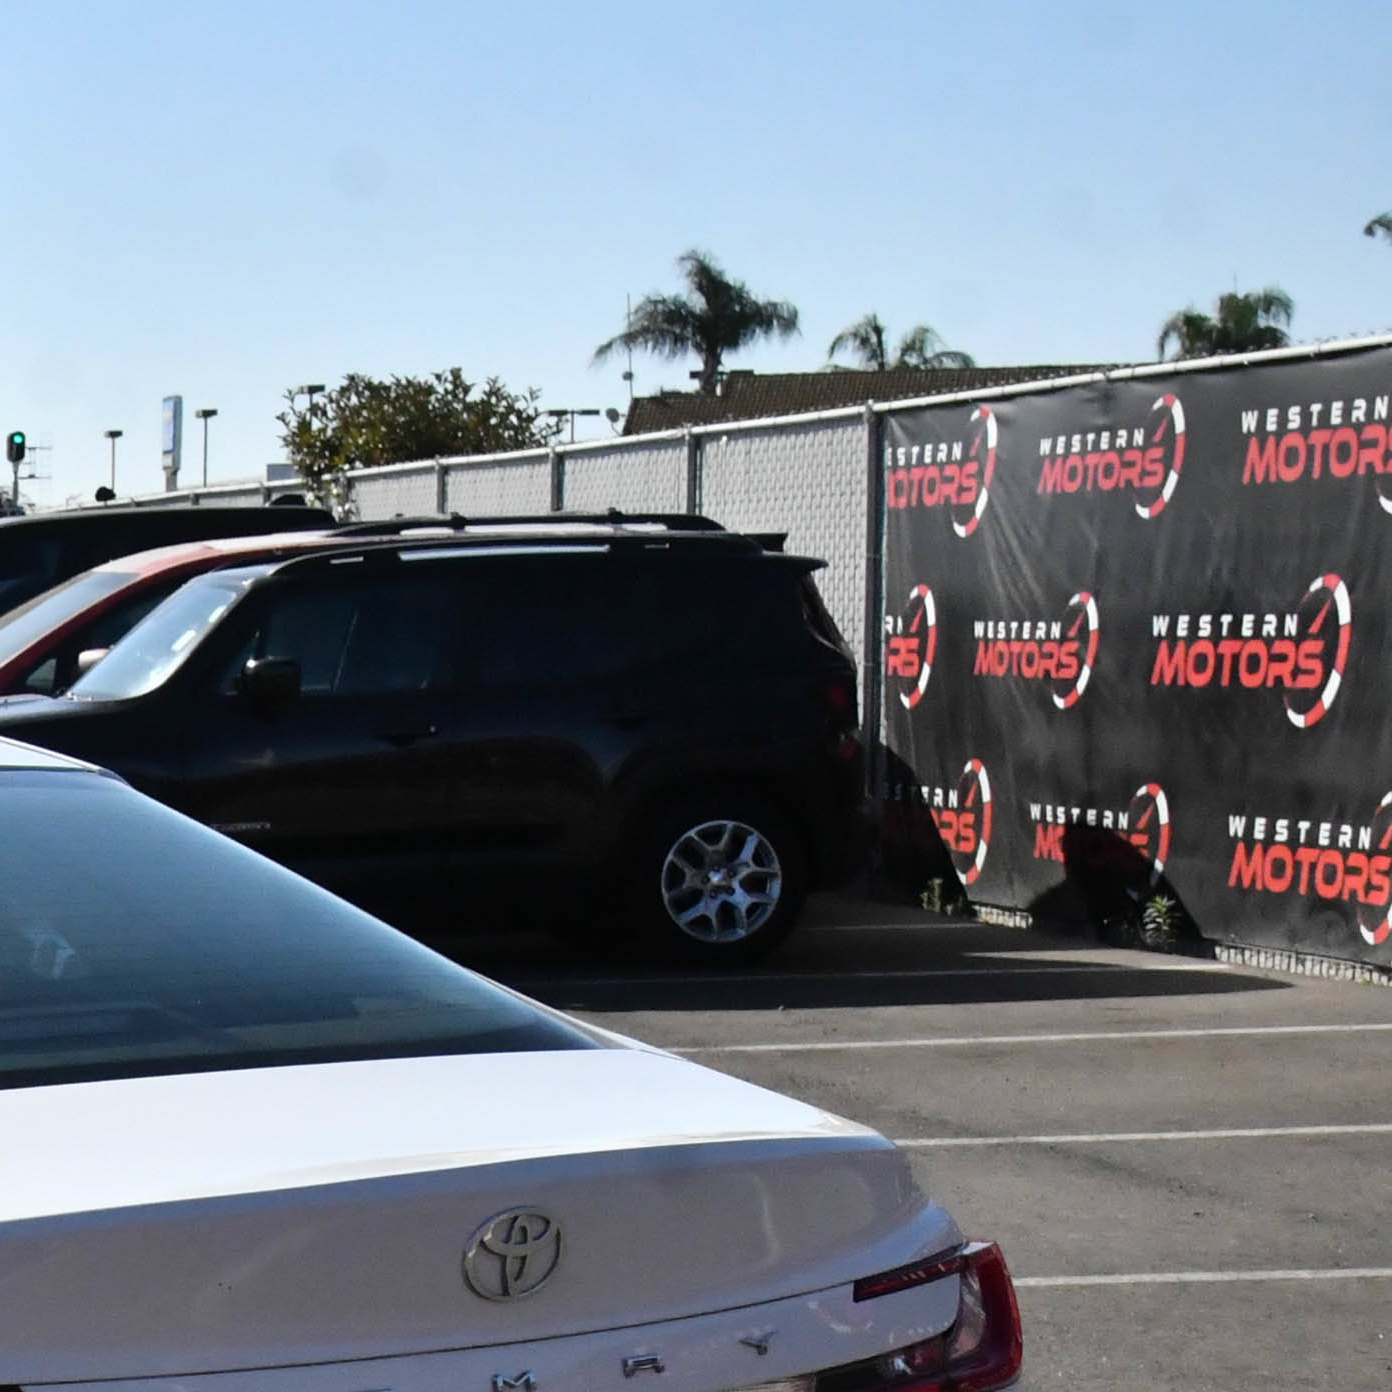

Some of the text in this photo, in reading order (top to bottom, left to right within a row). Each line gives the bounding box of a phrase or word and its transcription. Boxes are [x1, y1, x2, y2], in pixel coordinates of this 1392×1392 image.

[1242, 395, 1389, 434] WESTERN
[1039, 427, 1145, 456] WESTERN
[1241, 423, 1392, 485] MOTOR
[1037, 446, 1165, 495] MOTORS
[974, 620, 1062, 640] WESTERN
[1152, 613, 1299, 638] WESTERN
[973, 640, 1081, 679] MOTORS
[1150, 638, 1326, 689] MOTORS
[1030, 803, 1129, 830] WESTERN
[1228, 814, 1372, 850] WESTERN
[1227, 840, 1392, 906] MOTORS
